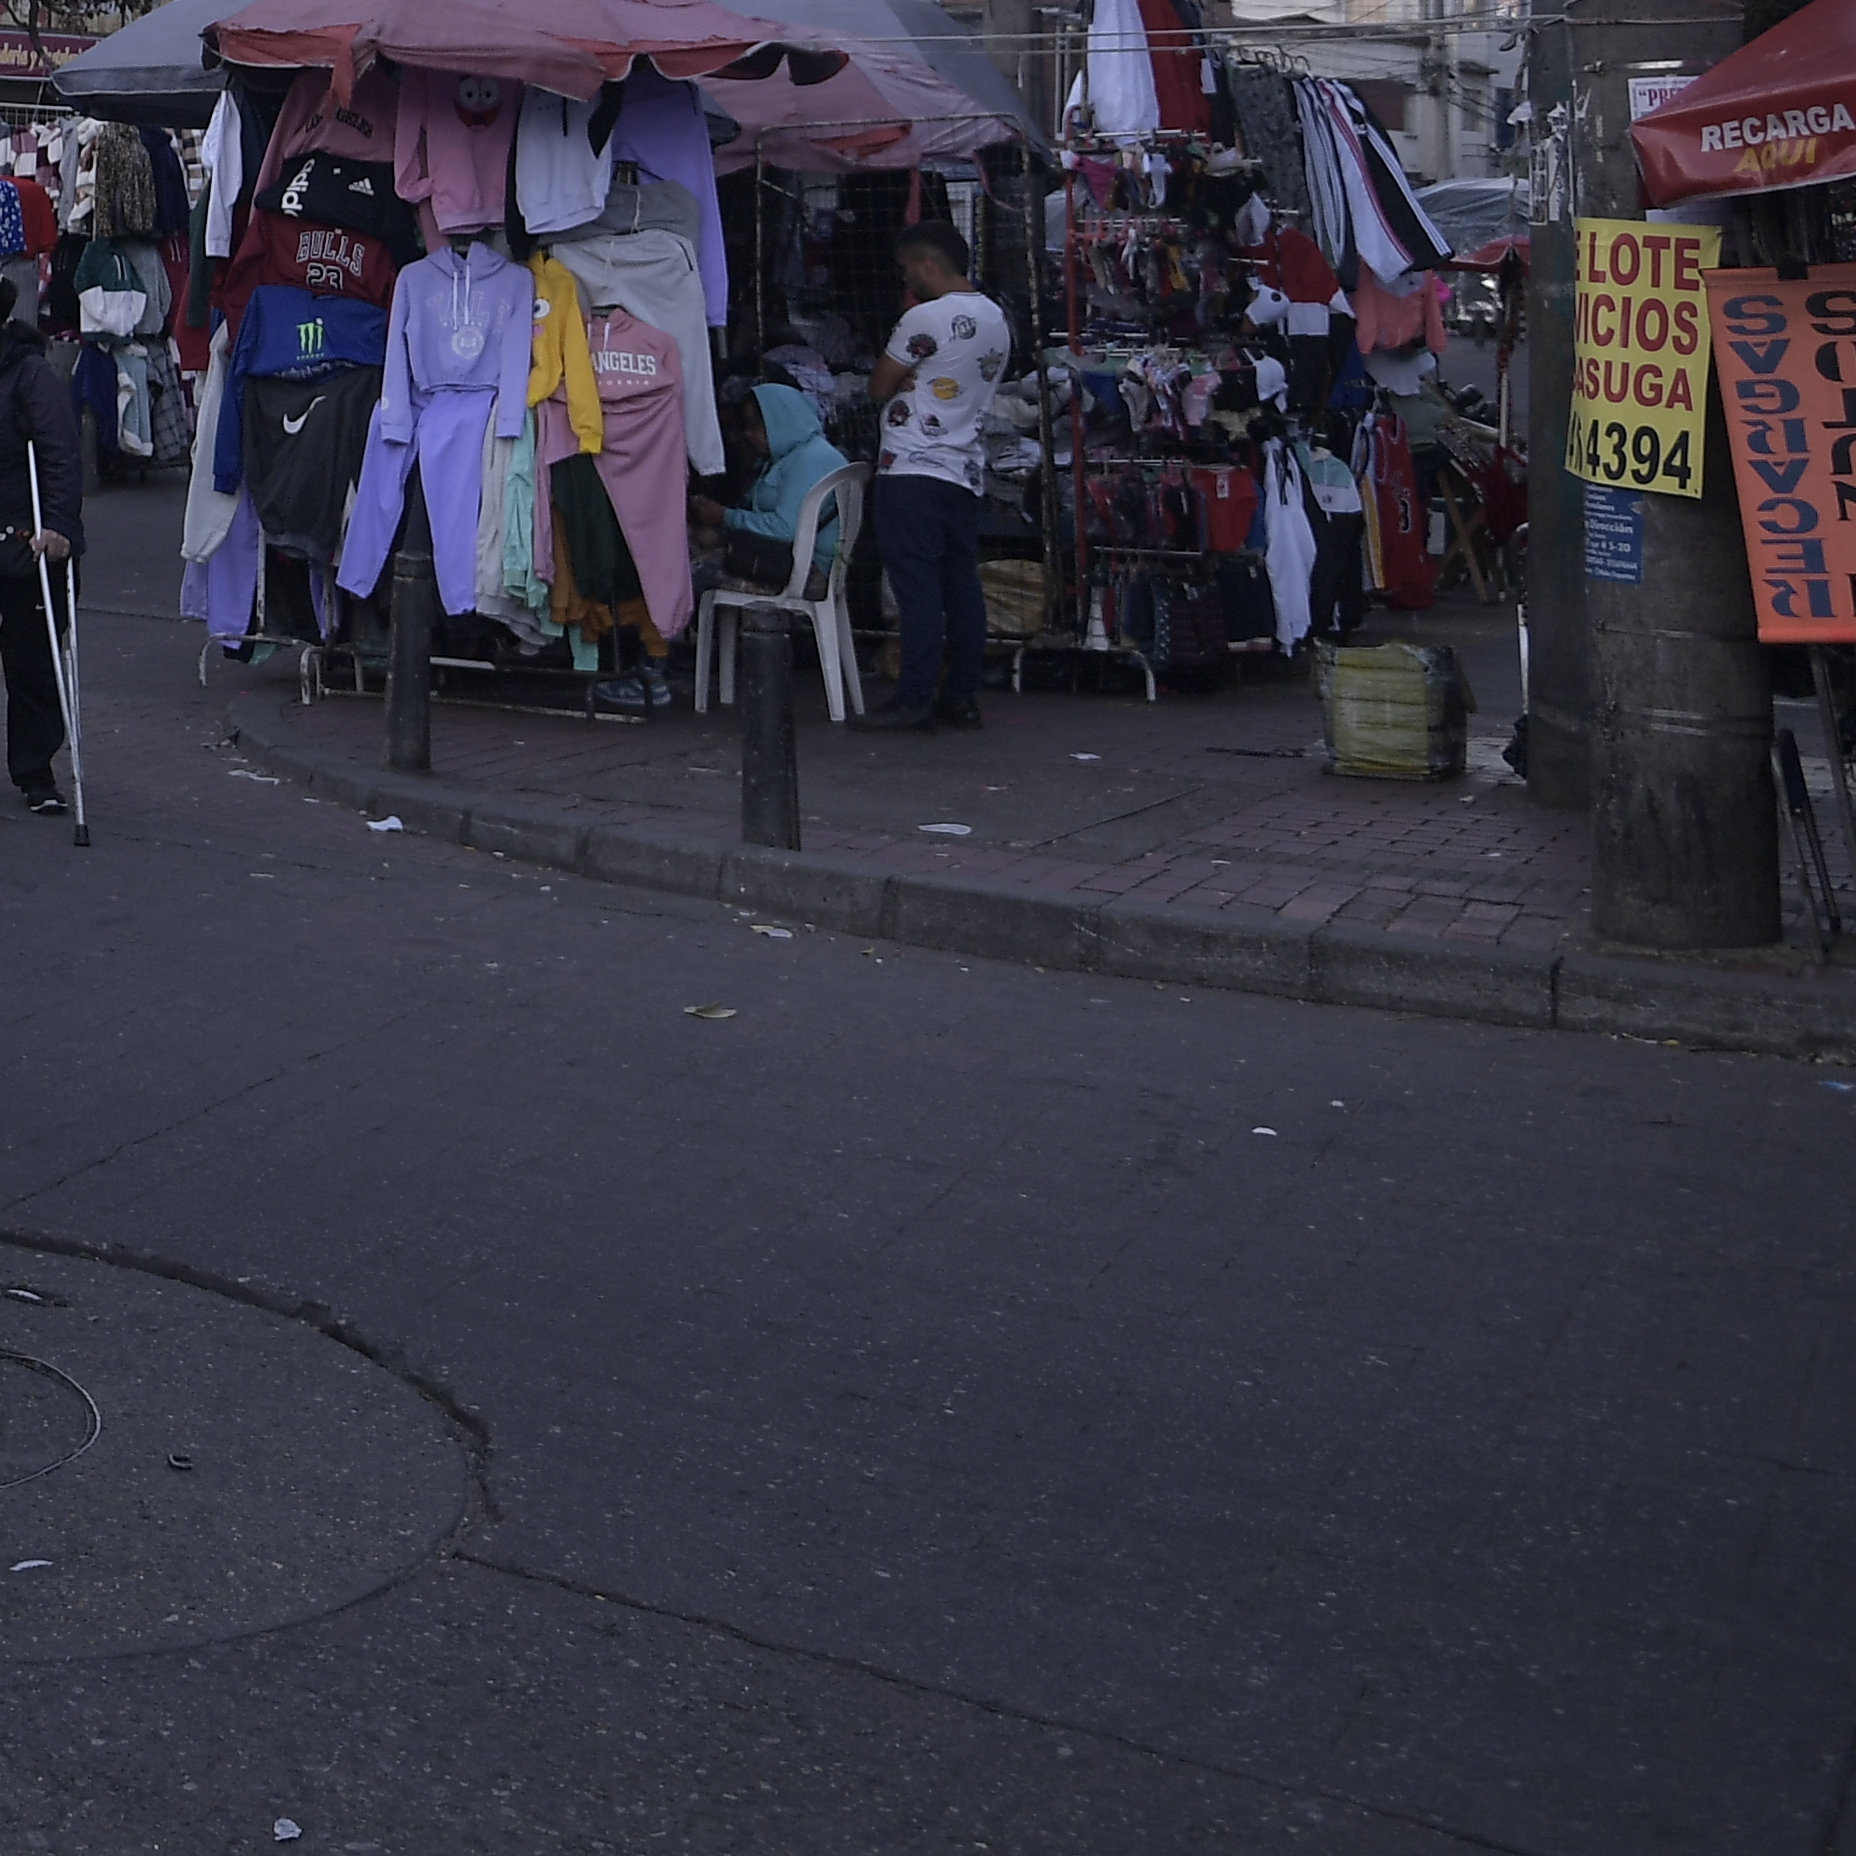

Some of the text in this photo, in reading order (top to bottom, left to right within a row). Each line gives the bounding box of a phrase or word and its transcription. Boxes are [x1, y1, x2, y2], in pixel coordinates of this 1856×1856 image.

[1700, 103, 1855, 152] RECARGA
[1734, 137, 1818, 173] AQUI
[296, 230, 365, 276] BULLS
[1588, 231, 1701, 292] LOTE
